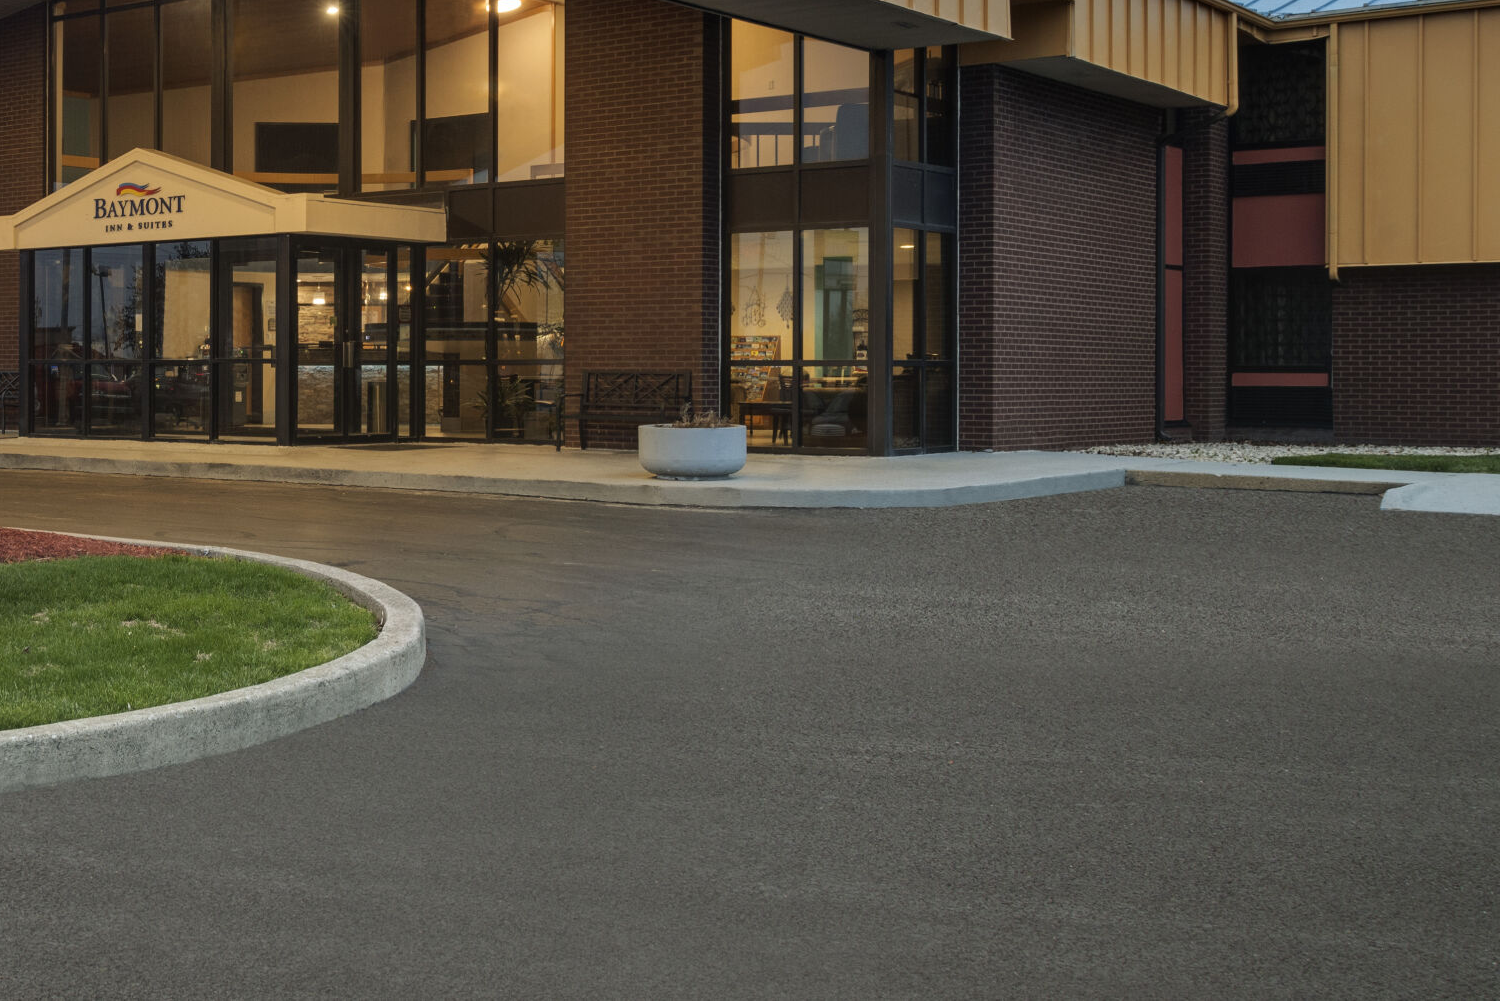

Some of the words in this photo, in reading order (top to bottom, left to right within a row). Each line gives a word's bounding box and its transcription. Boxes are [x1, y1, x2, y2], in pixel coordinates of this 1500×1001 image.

[93, 195, 185, 219] BAYMONT
[105, 224, 123, 233] INN
[127, 223, 134, 231] &
[138, 220, 173, 230] SUITES
